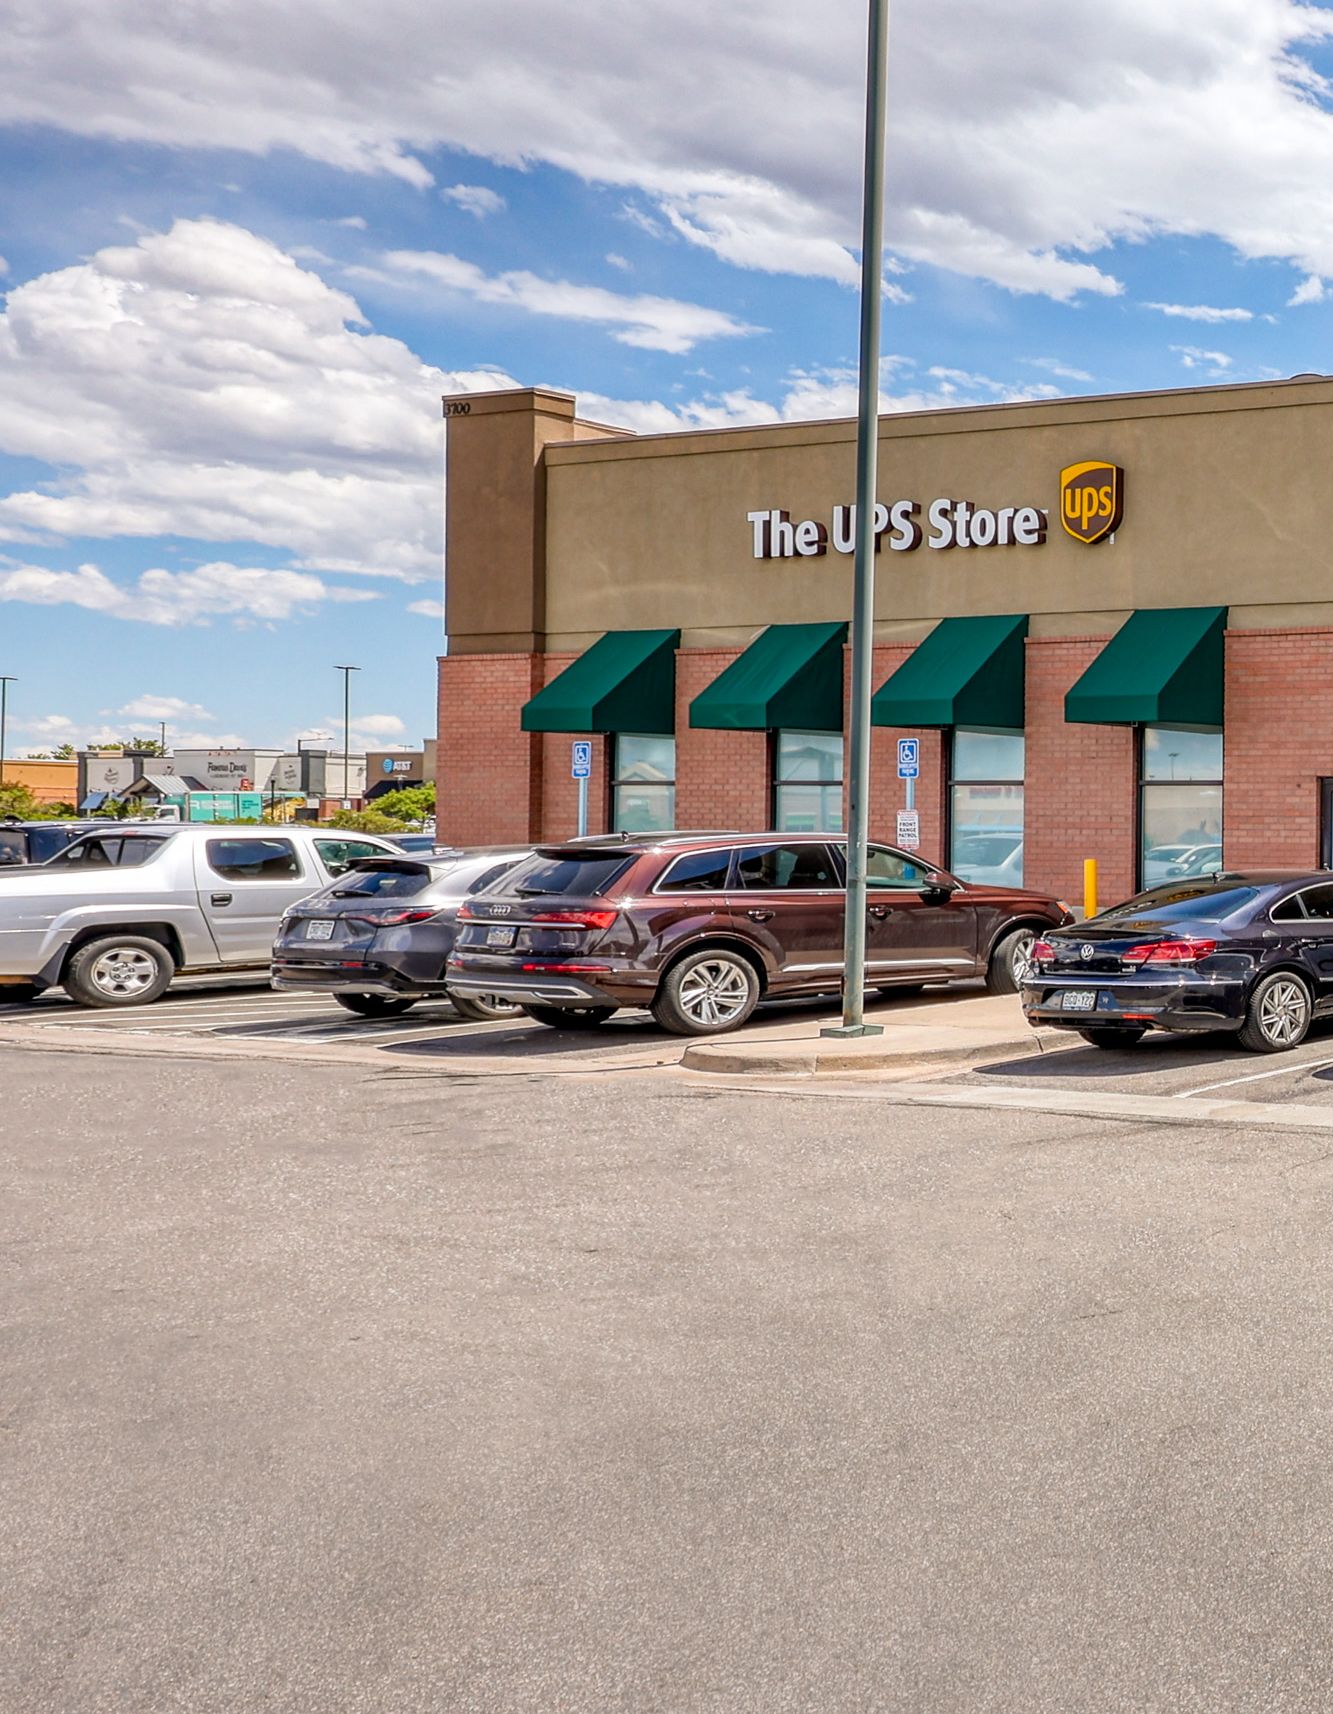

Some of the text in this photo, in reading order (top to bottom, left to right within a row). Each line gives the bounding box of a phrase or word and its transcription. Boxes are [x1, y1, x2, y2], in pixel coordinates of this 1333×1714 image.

[747, 509, 824, 558] The
[929, 498, 1044, 550] Store
[1065, 486, 1112, 530] ups
